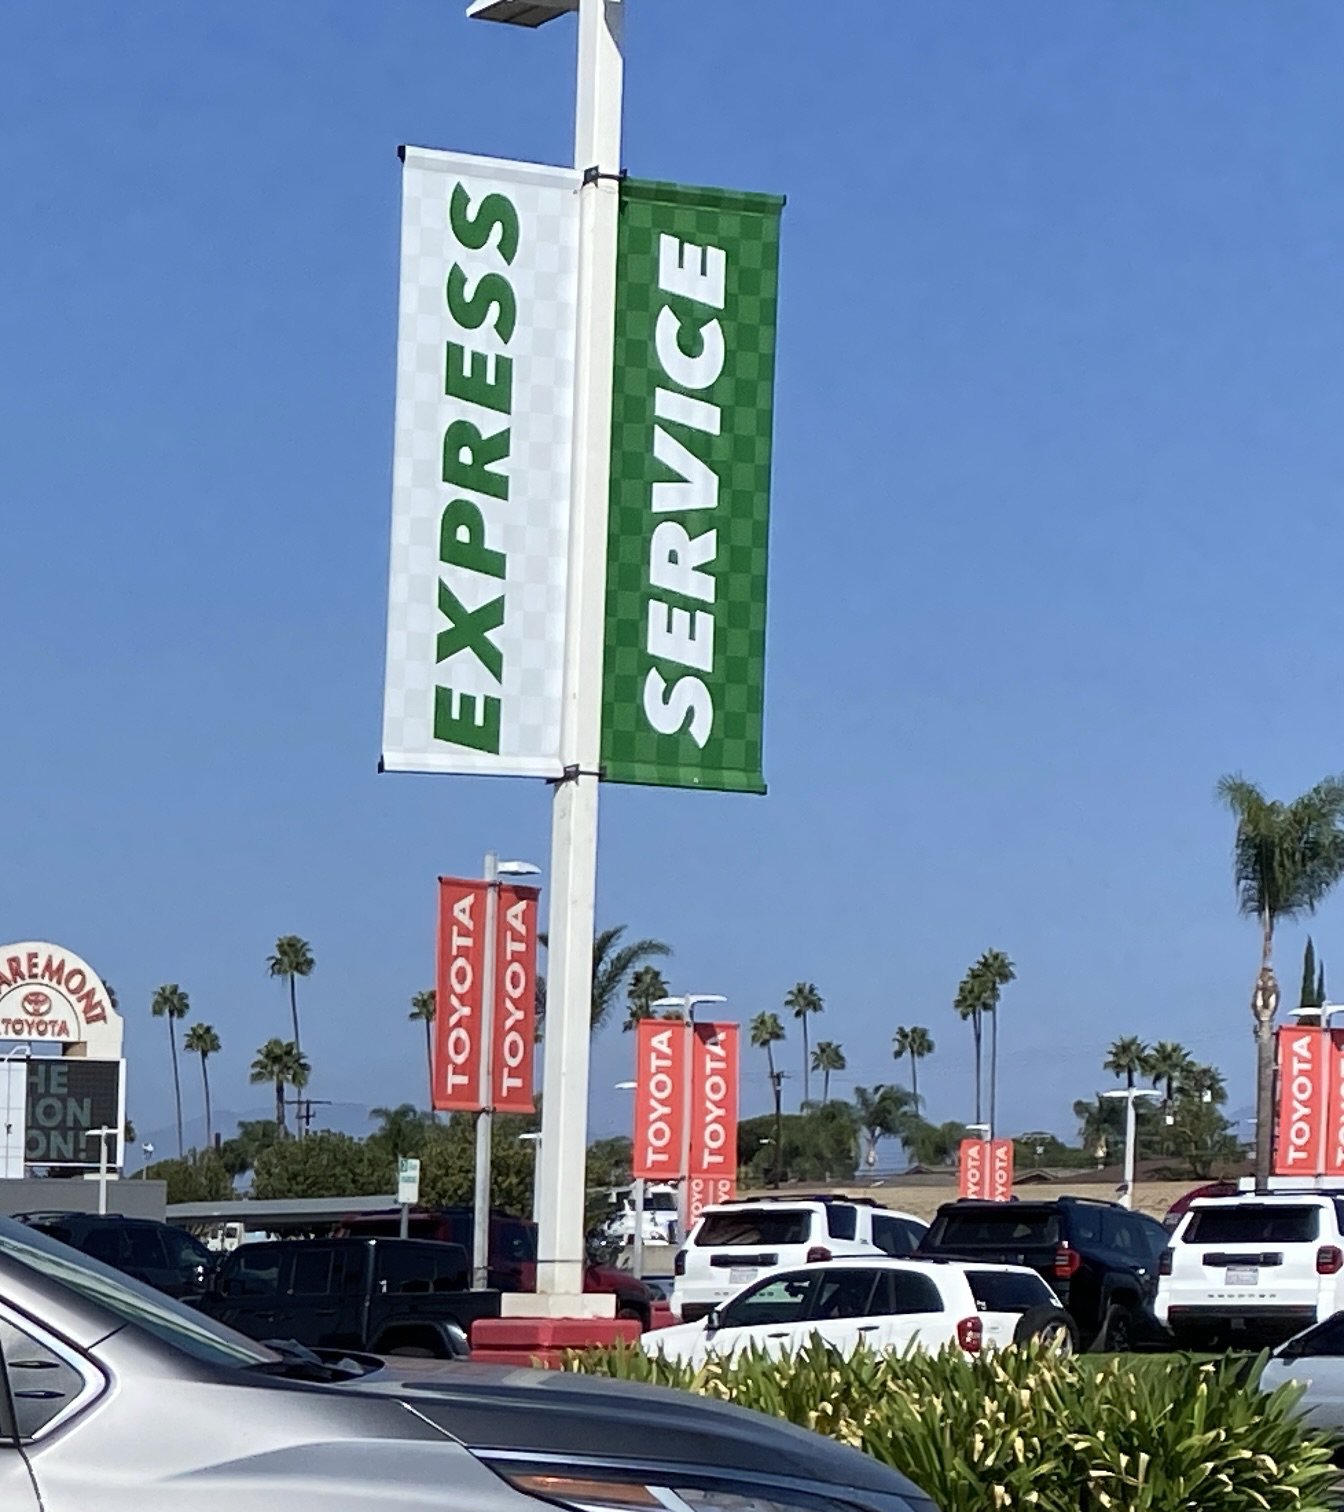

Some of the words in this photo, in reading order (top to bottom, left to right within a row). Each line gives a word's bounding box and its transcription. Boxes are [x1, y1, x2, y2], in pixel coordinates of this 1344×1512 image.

[432, 181, 521, 755] EXPRESS
[643, 233, 727, 749] SERVICE
[1, 1018, 70, 1037] TOYOTA
[446, 893, 475, 1095] TOYOTA
[501, 900, 528, 1098] TOYOTA
[646, 1029, 673, 1169] TOYOTA
[702, 1031, 727, 1170] TOYOTA
[1287, 1034, 1312, 1166] TOYOTA
[967, 1145, 981, 1199] YOTA
[994, 1146, 1008, 1201] YOTA
